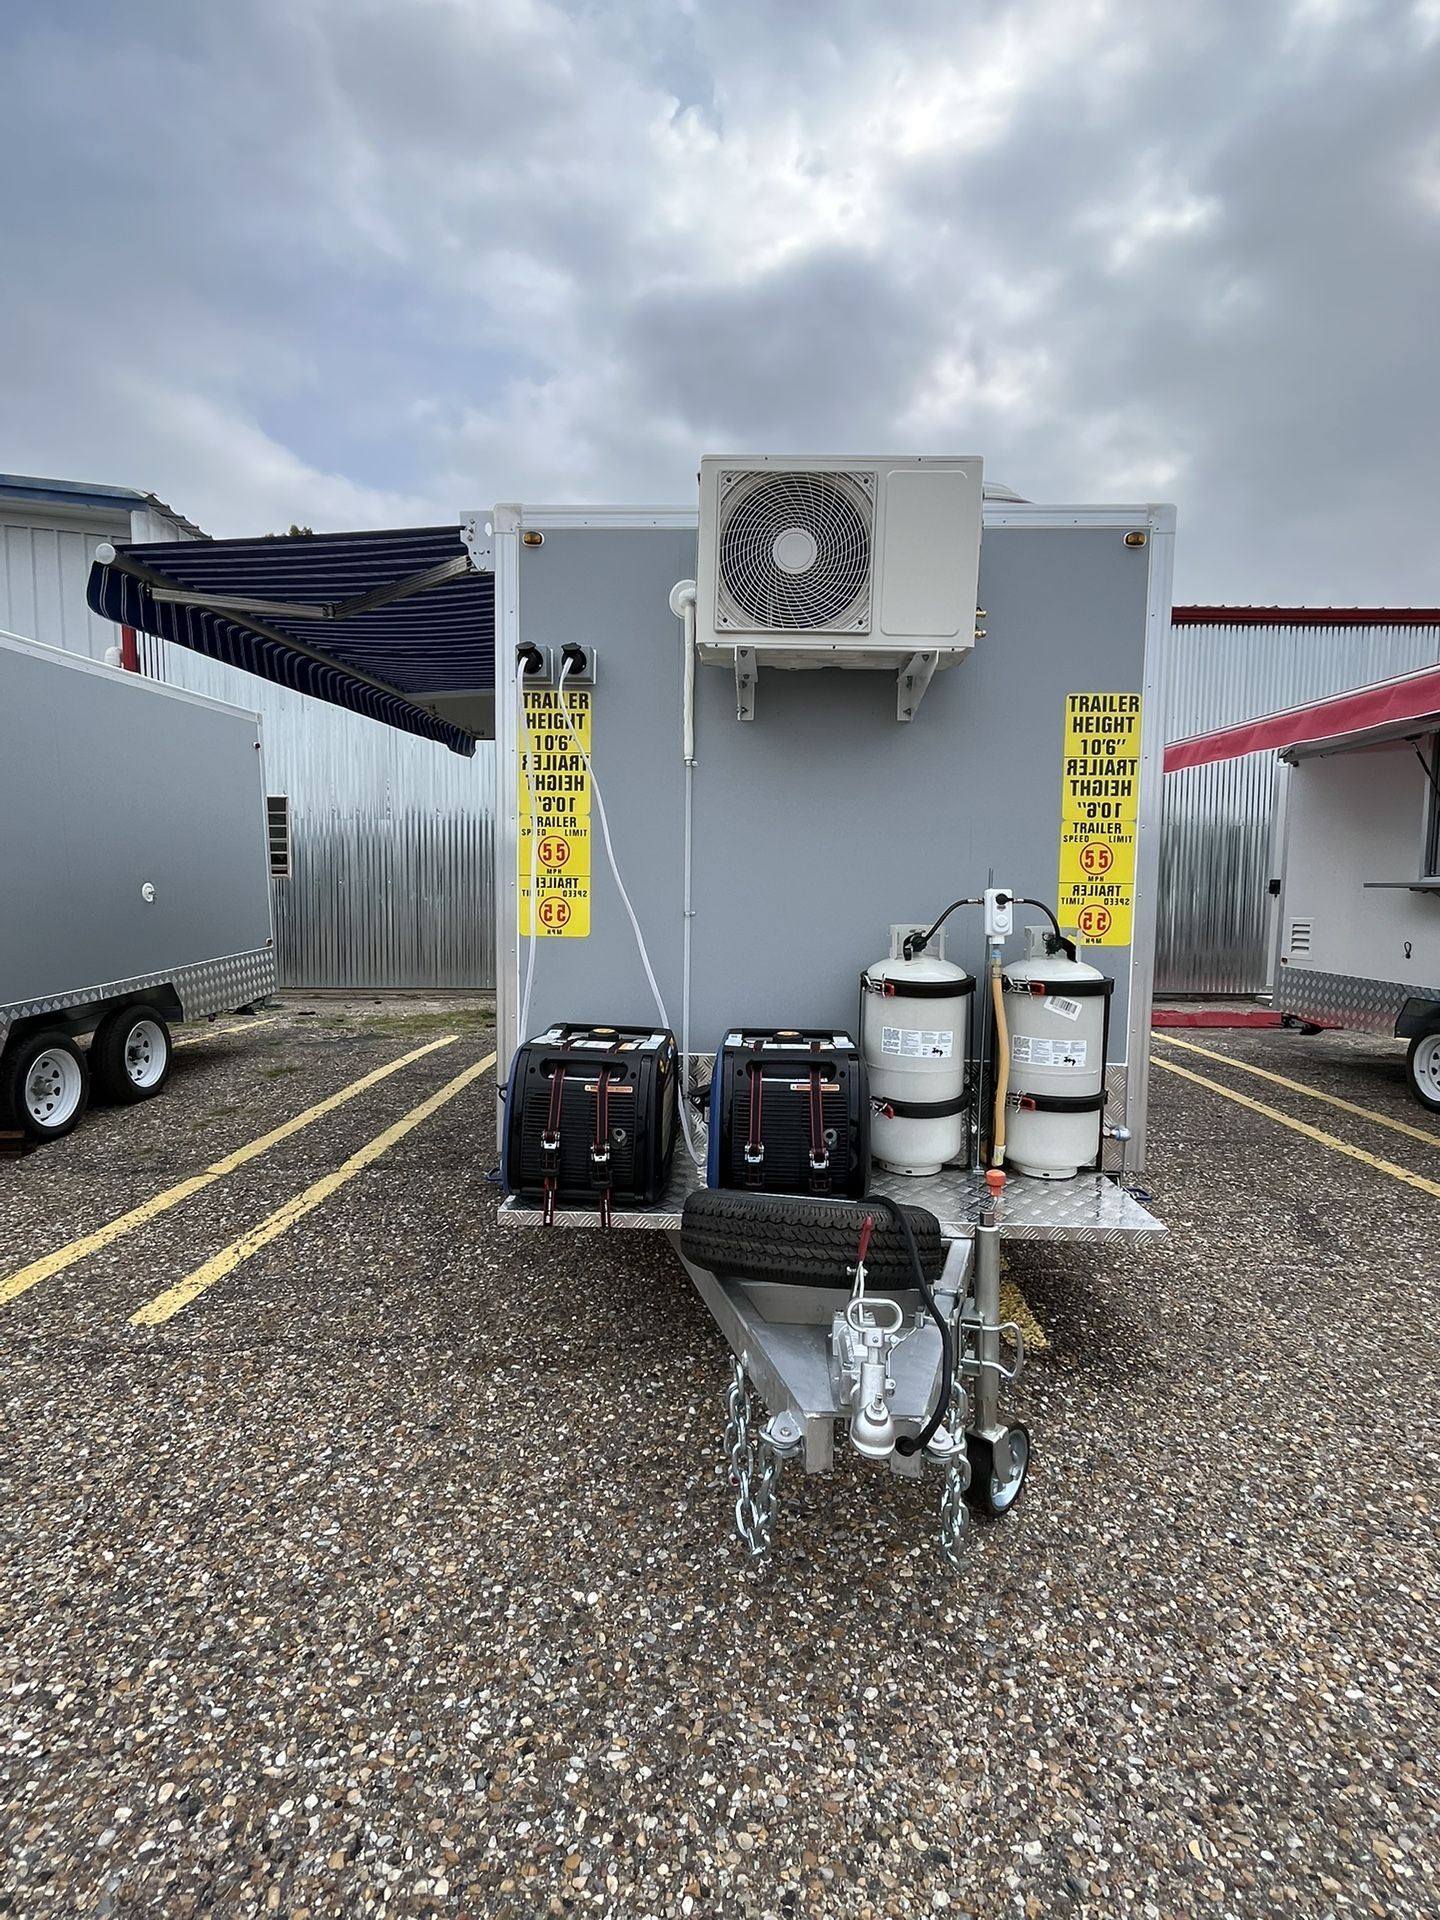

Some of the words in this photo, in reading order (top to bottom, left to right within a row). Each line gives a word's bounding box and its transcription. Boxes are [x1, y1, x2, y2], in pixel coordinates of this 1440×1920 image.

[523, 692, 589, 709] TRAIER
[1069, 696, 1139, 712] TRAILER
[1073, 717, 1135, 733] HEIGHT
[530, 816, 577, 827] RAILER
[1073, 822, 1121, 834] TRAILER
[543, 844, 565, 861] 55
[1085, 850, 1108, 868] 55
